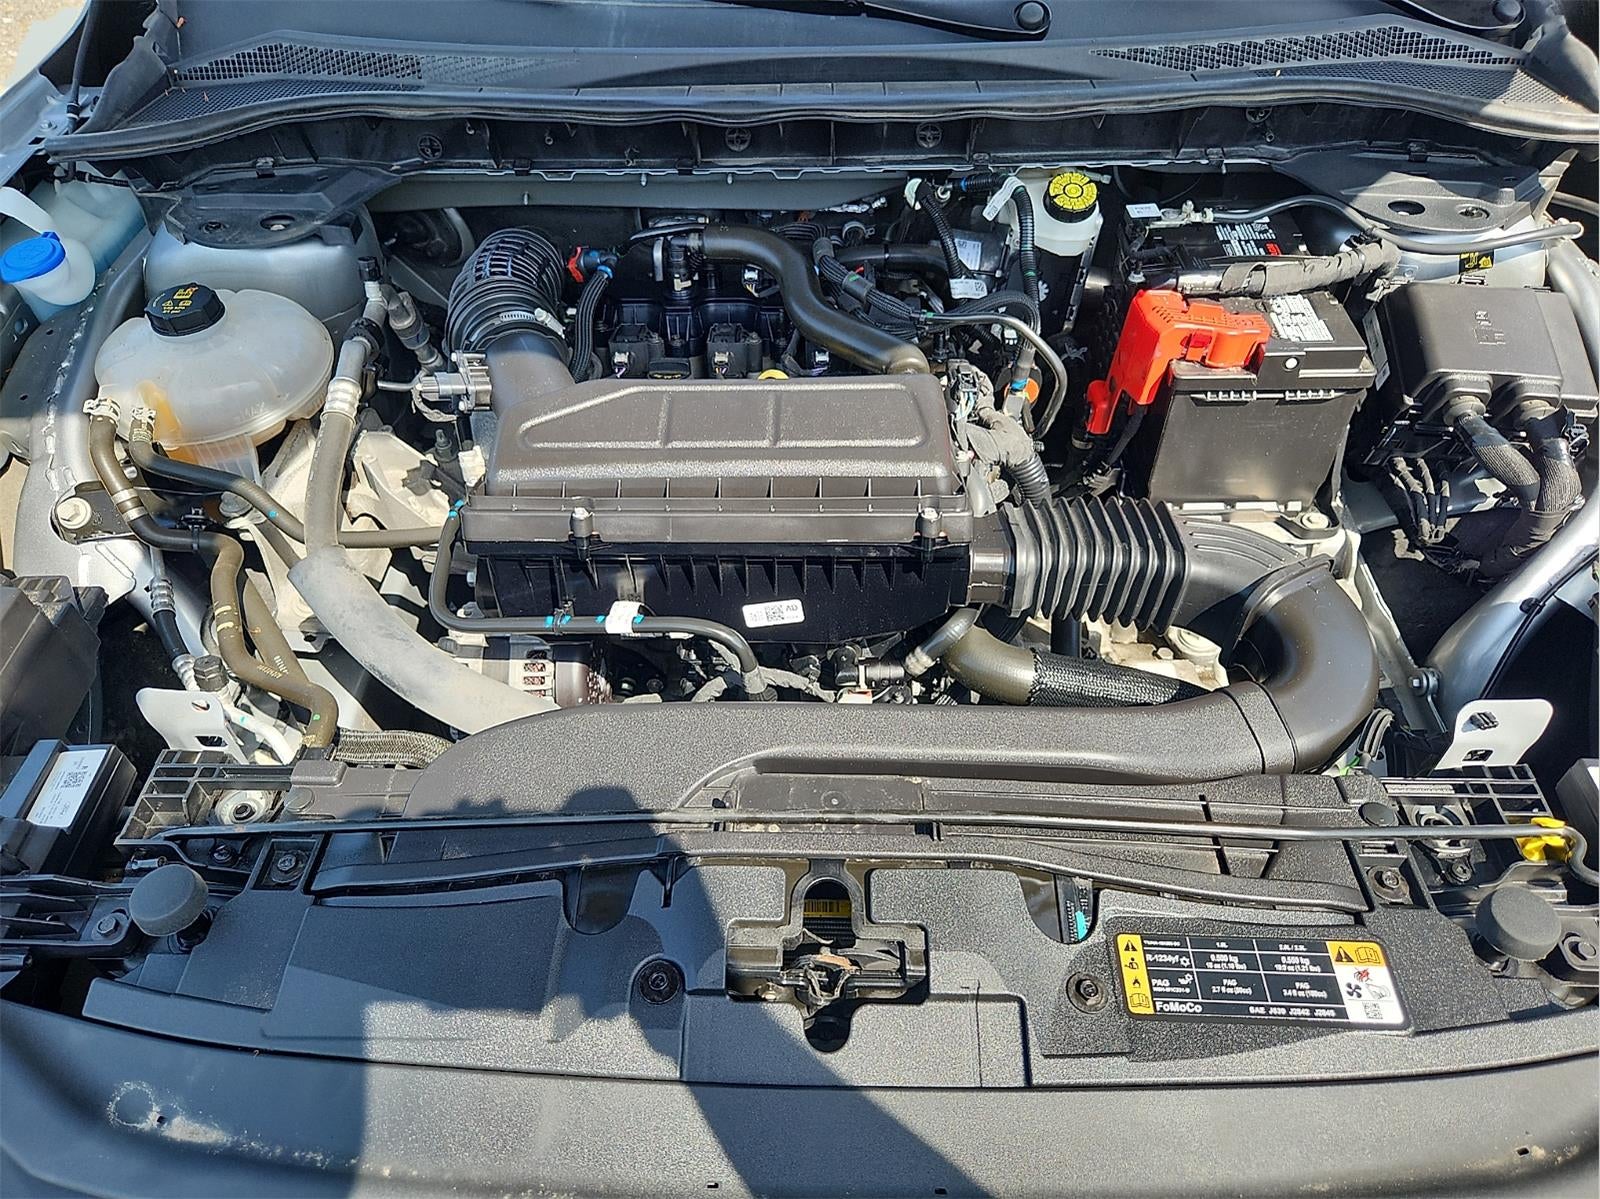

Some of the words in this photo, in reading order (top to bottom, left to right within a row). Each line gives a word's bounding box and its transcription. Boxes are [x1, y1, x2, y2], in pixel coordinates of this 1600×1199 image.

[1146, 954, 1180, 964] R-1234yf
[1229, 954, 1239, 964] kg
[1300, 957, 1310, 966] kg
[1156, 1002, 1202, 1013] FoMoCo
